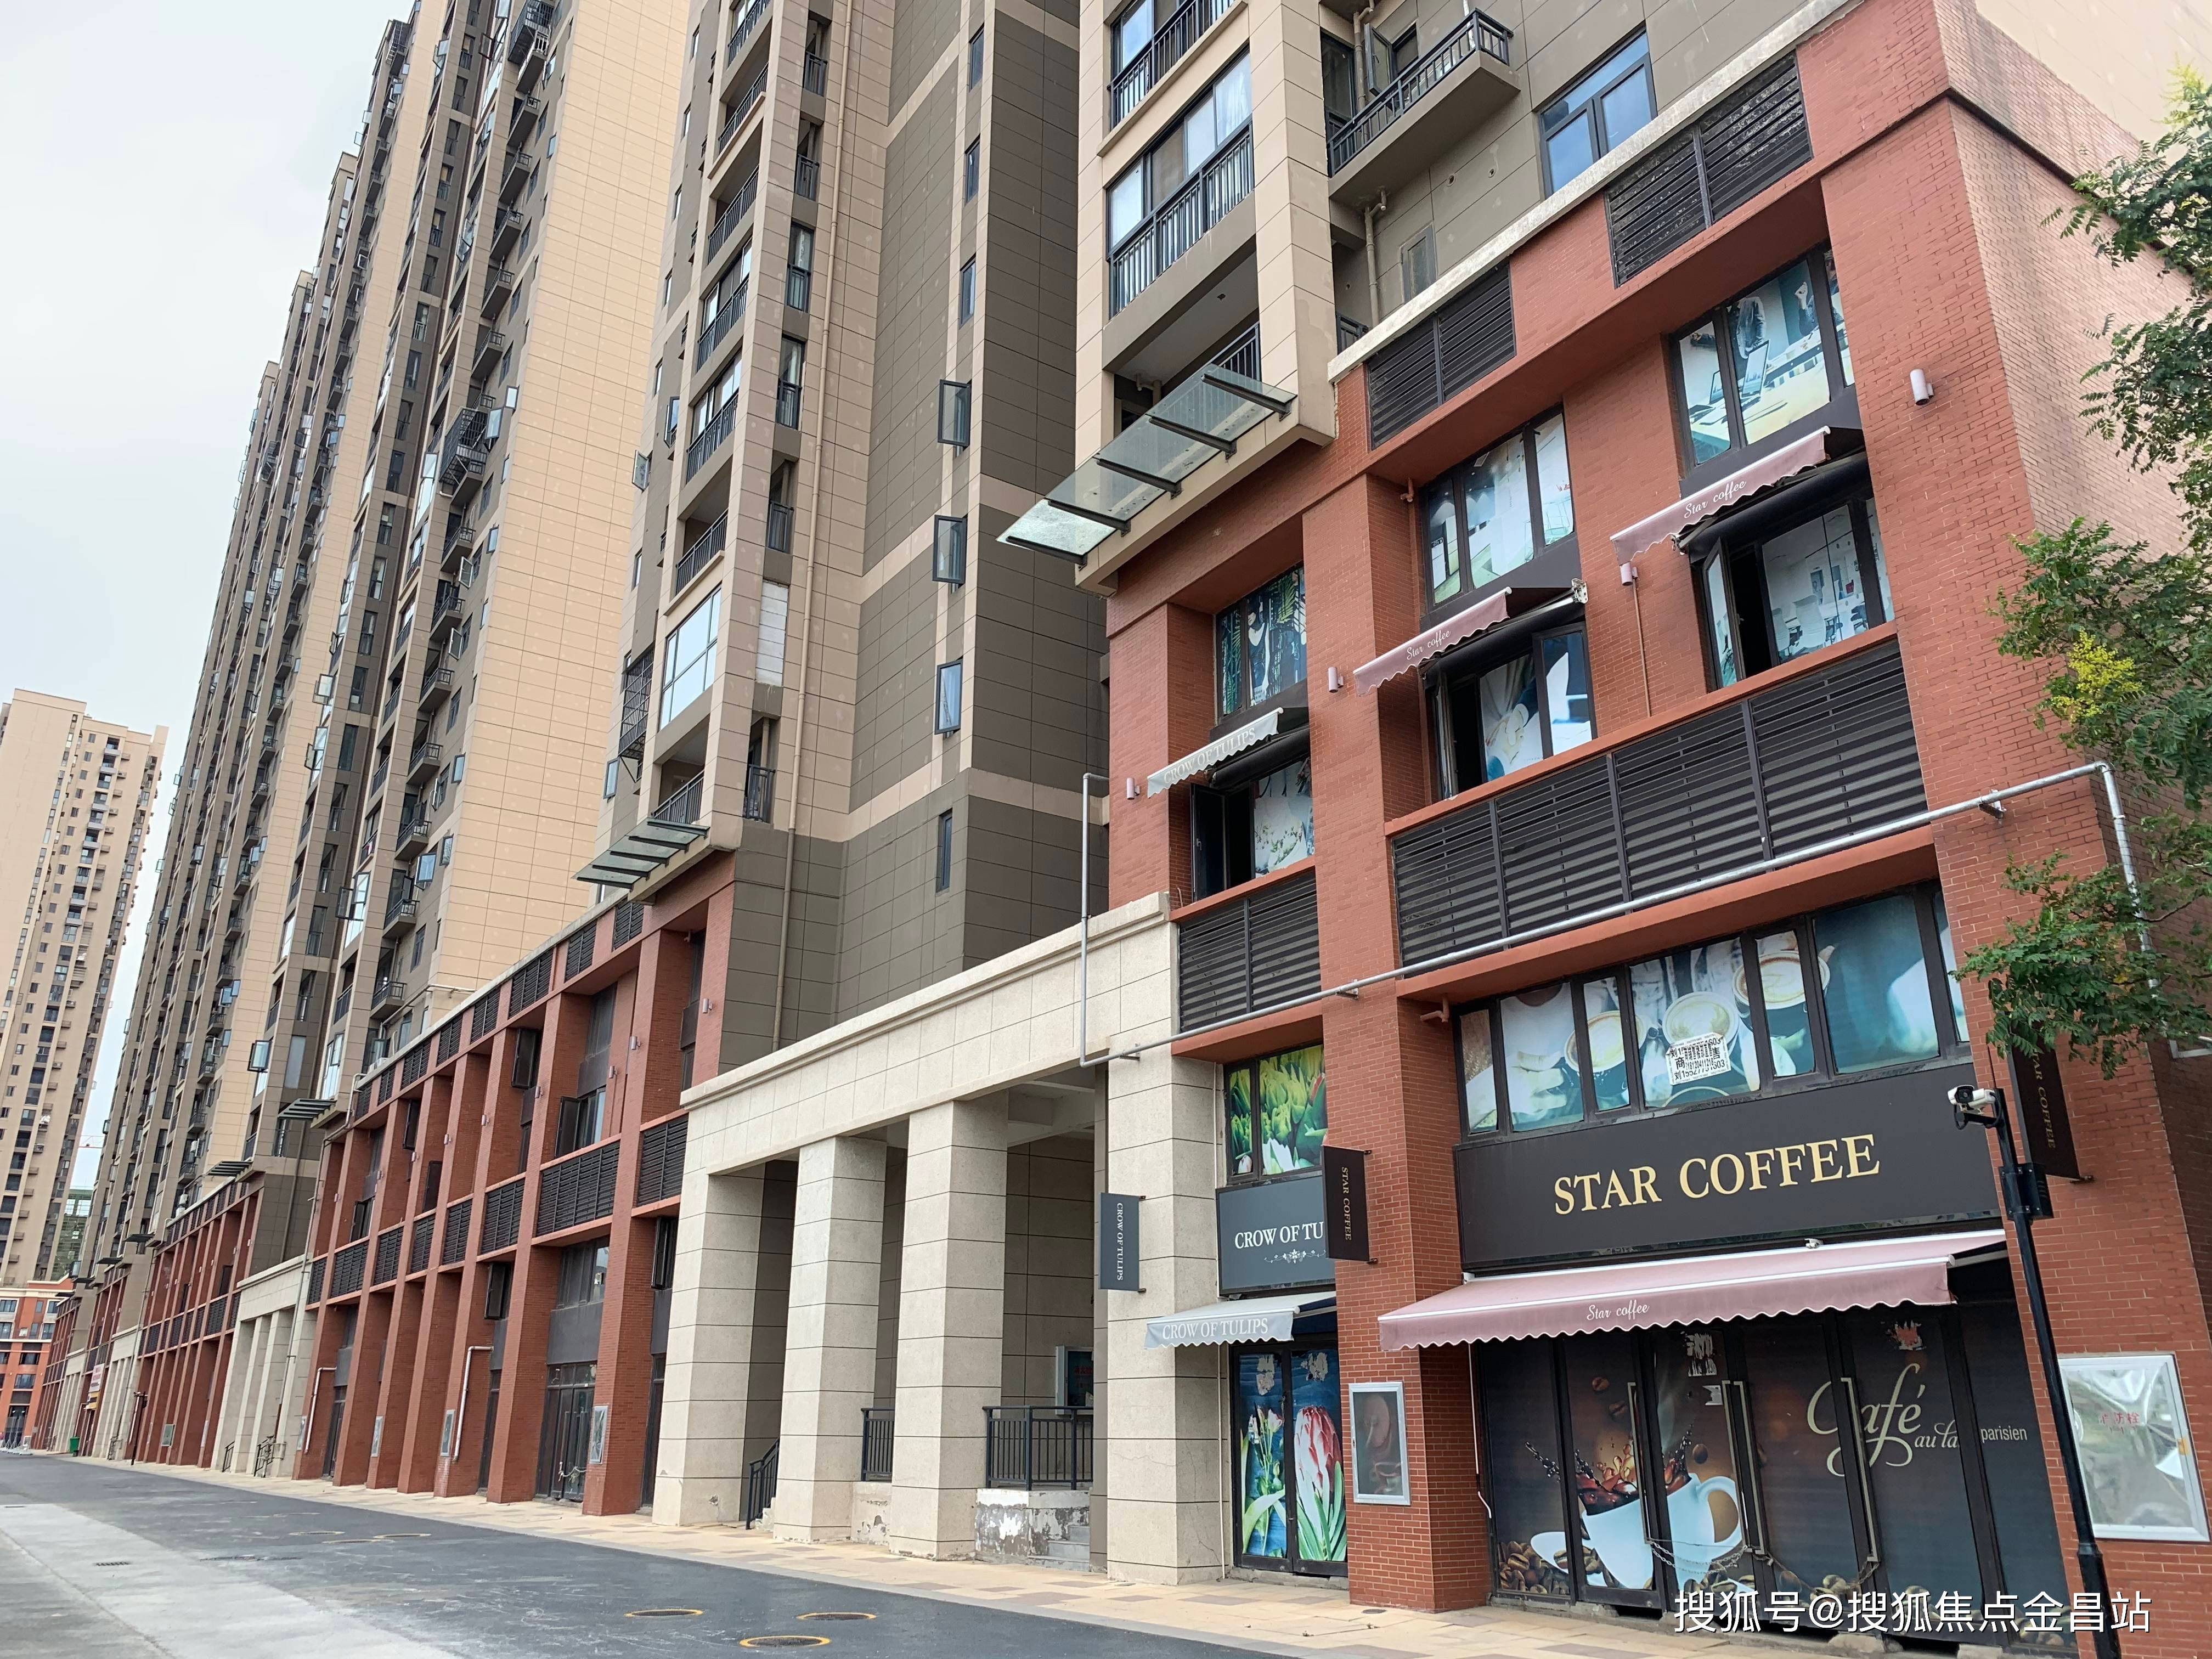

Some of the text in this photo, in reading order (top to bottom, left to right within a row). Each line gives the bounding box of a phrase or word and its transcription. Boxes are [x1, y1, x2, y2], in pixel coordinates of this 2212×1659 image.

[1684, 481, 1746, 518] Star coffee
[1407, 630, 1451, 660] Star coffee
[1164, 727, 1255, 783] CROW OF TULIPS
[2033, 1052, 2056, 1148] TAR COFFEE
[1555, 1134, 1881, 1215] STAR COFFEE
[1344, 1198, 1352, 1240] COFFEE
[1117, 1232, 1124, 1245] OF
[1234, 1228, 1277, 1249] CROW
[1280, 1224, 1300, 1243] OF
[1587, 1299, 1650, 1321] Star coffee
[1163, 1318, 1268, 1340] CROW OF TULIPS
[1914, 1435, 1936, 1448] au
[1981, 1426, 2028, 1444] parisien
